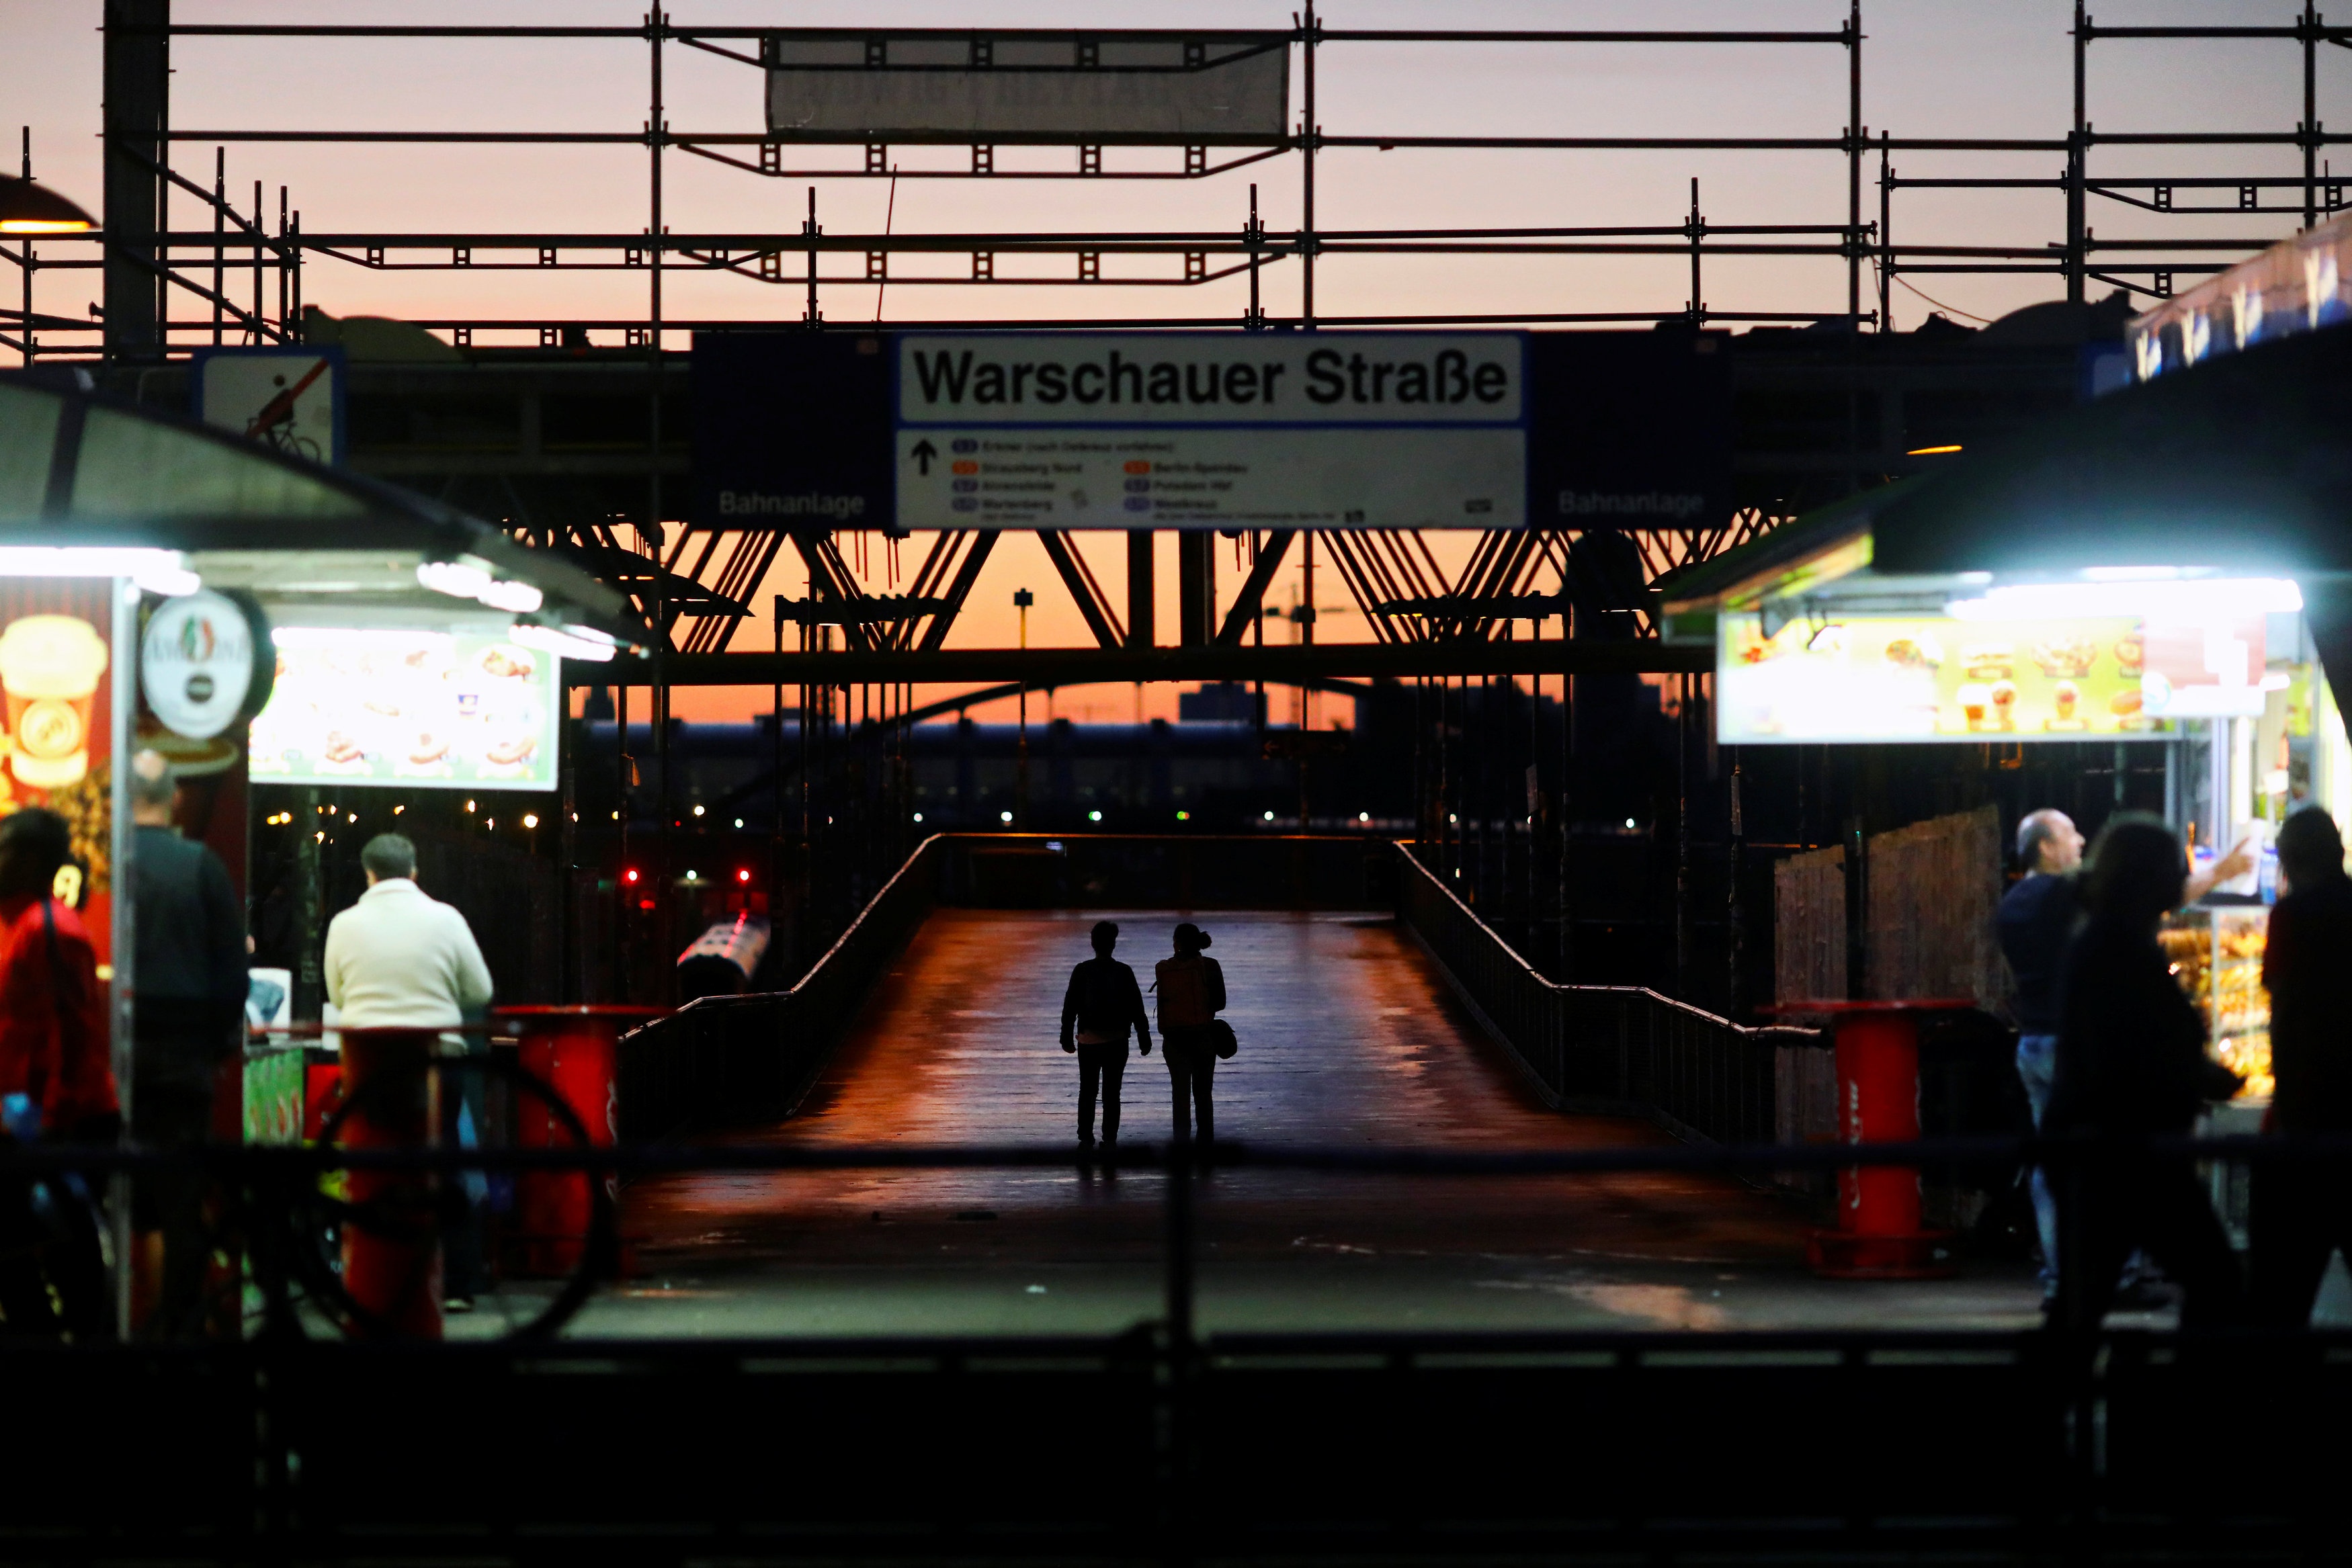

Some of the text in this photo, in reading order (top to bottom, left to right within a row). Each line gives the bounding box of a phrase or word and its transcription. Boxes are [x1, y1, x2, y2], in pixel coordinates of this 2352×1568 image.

[913, 349, 1507, 405] Warschauer Straße
[719, 491, 864, 520] Bahnanlage
[1558, 489, 1704, 519] Bahnanlage
